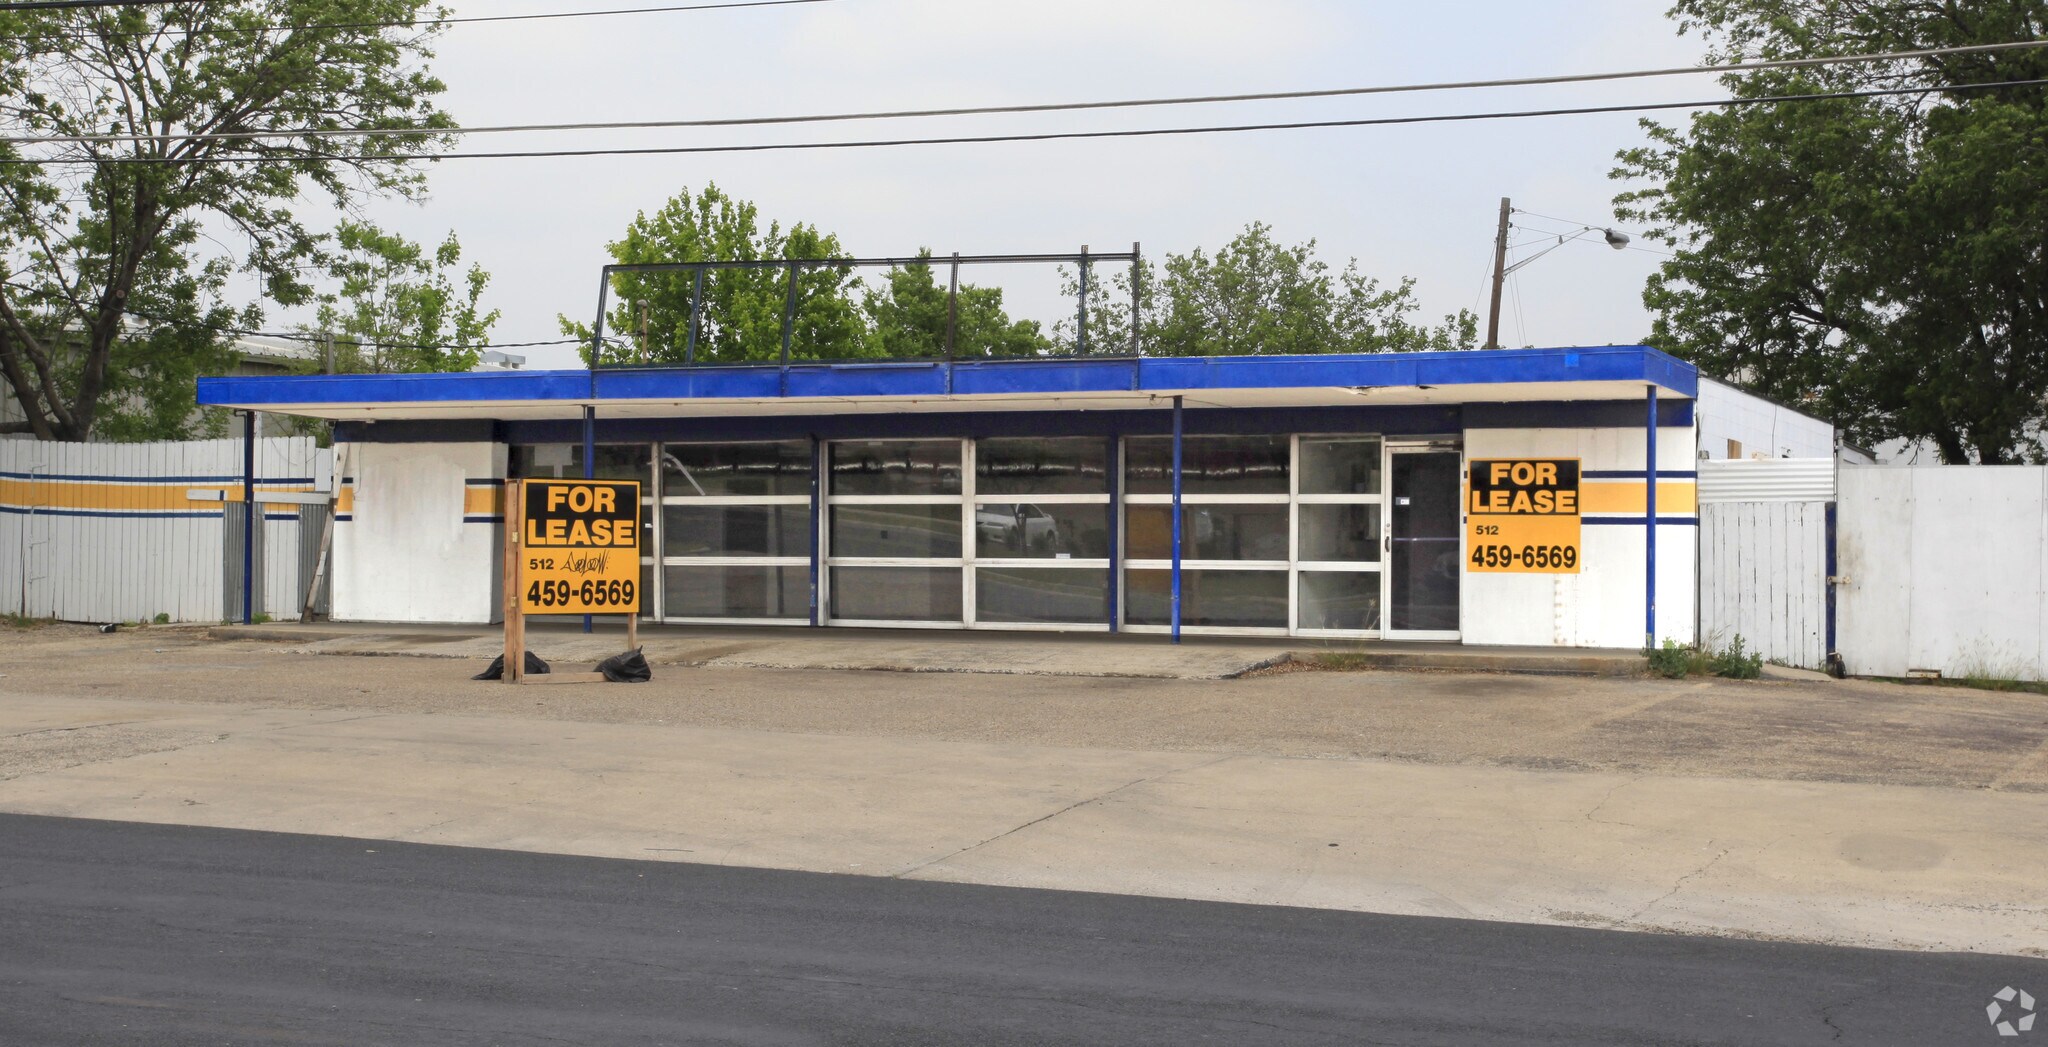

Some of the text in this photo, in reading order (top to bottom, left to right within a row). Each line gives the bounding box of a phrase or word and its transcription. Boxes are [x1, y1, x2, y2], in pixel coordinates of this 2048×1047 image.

[1490, 462, 1557, 485] FOR
[548, 486, 615, 512] FOR
[1472, 490, 1576, 513] LEASE
[528, 519, 634, 546] LEASE
[1476, 525, 1499, 535] 512
[530, 558, 554, 570] 512
[1472, 545, 1576, 568] 459-6569
[528, 579, 635, 607] 459-6569
